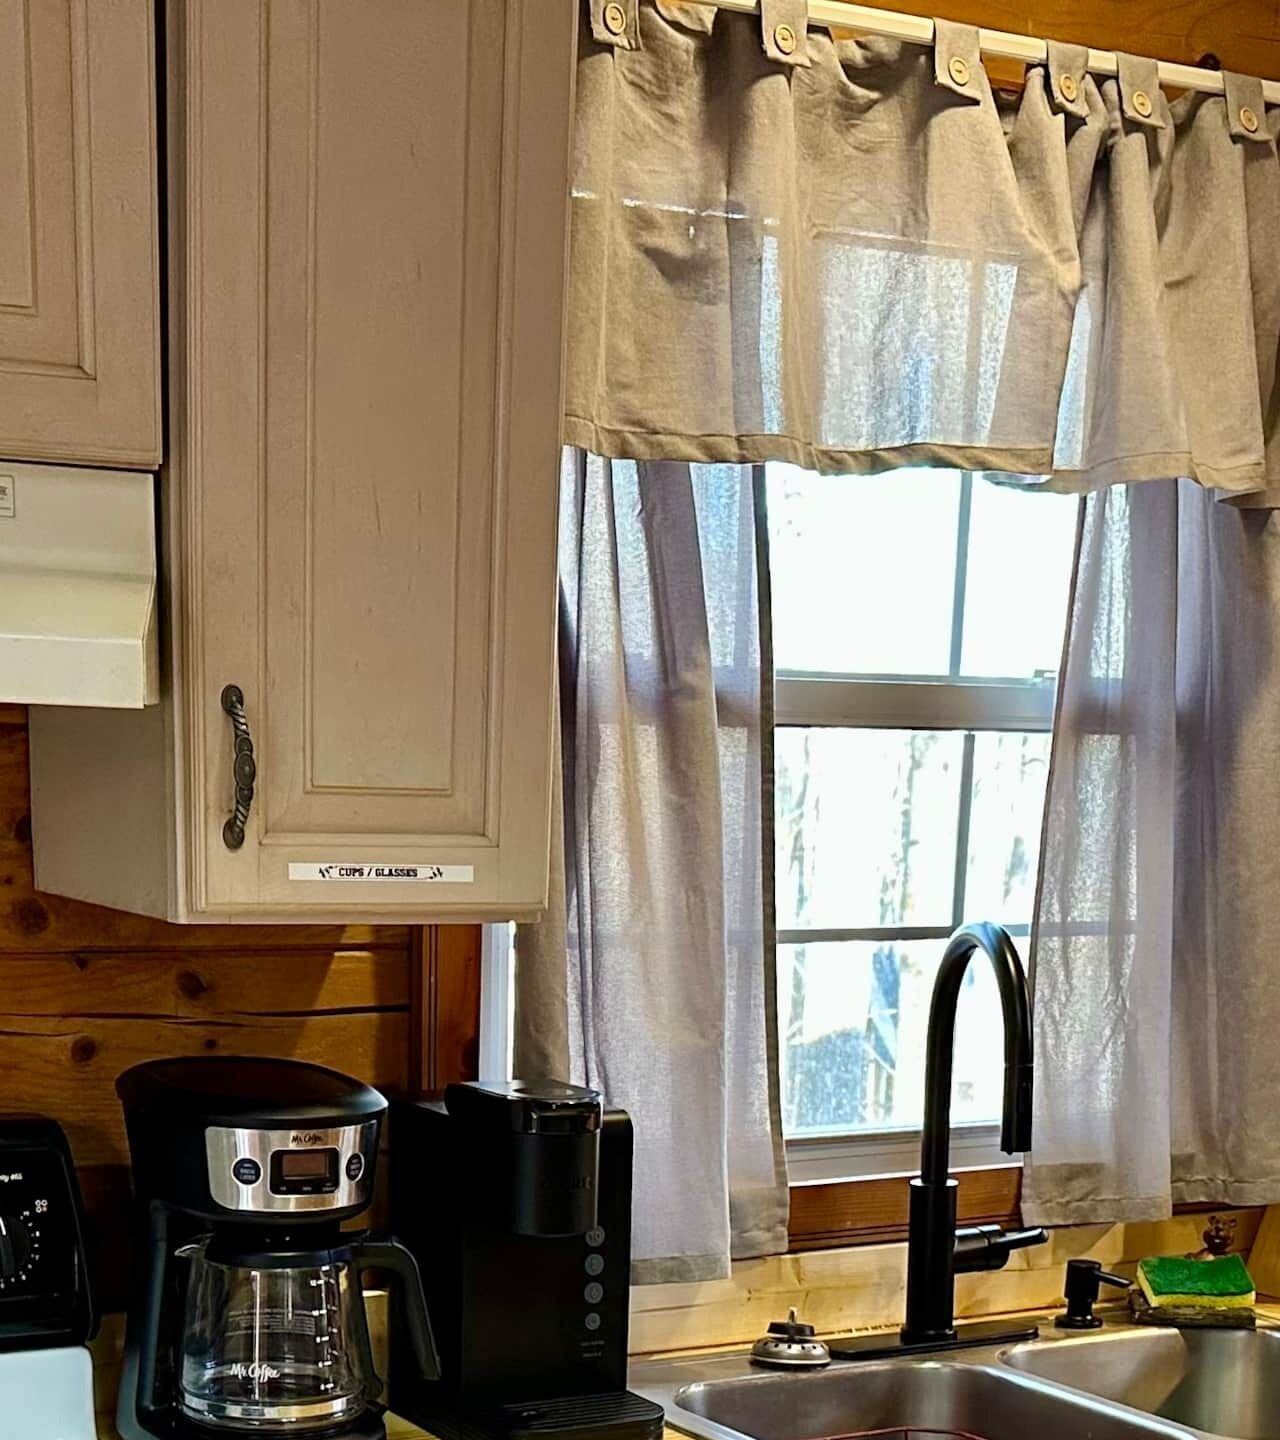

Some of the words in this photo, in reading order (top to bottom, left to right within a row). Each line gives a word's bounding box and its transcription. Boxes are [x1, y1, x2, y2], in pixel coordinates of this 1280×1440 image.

[338, 867, 364, 877] CUPS
[375, 868, 418, 877] GLASSES
[230, 1363, 248, 1380] Mr.
[248, 1362, 280, 1384] Coffee
